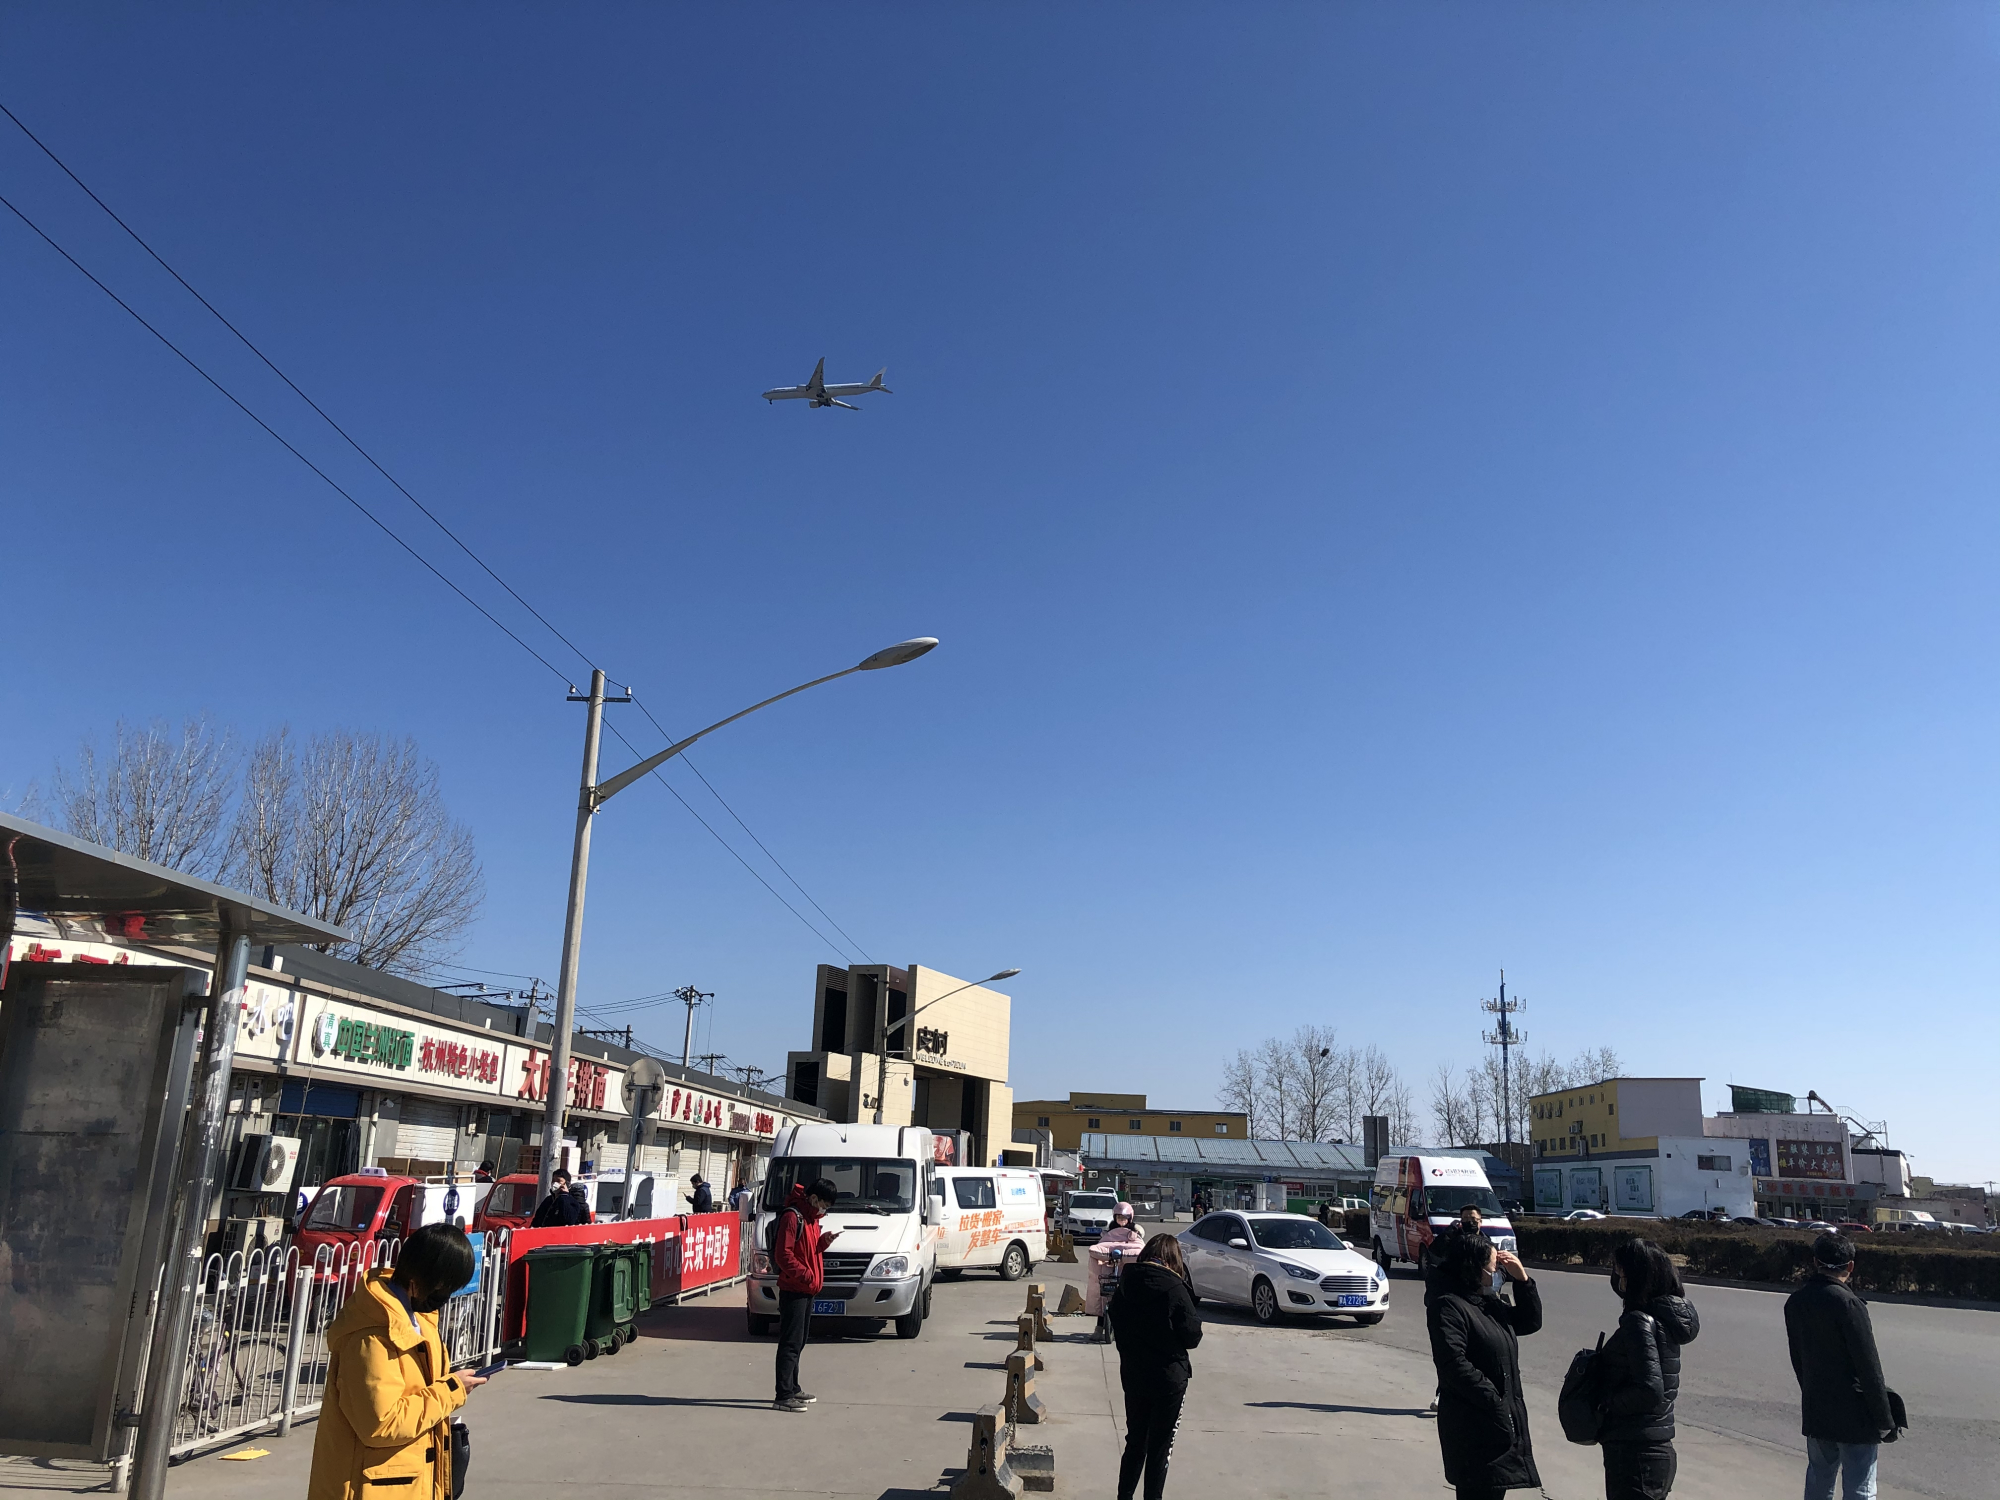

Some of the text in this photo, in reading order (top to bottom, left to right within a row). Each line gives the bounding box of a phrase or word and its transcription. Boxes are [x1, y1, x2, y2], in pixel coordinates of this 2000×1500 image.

[323, 1012, 336, 1049] 清真
[336, 1017, 416, 1068] 中国兰州拉面
[421, 1035, 500, 1083] 杭州特色小笼包
[965, 1227, 1007, 1254] 发整车
